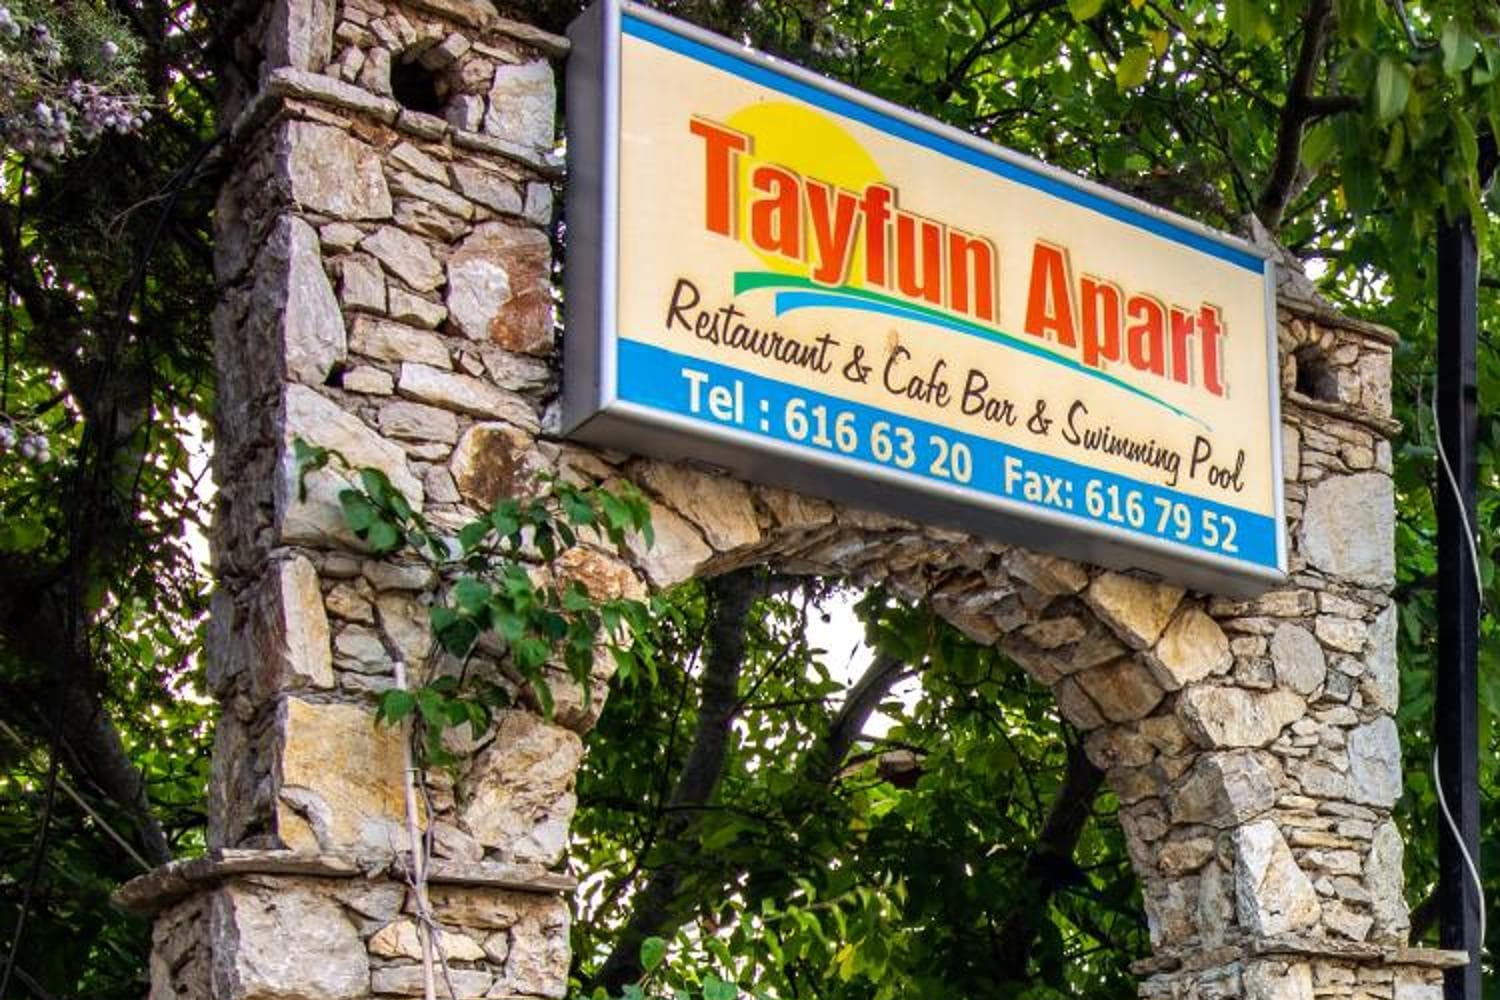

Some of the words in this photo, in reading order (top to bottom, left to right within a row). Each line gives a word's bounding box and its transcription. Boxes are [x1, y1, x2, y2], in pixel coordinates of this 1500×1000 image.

[689, 117, 995, 322] Tayfun
[1023, 242, 1224, 397] Apart
[665, 278, 840, 374] Restaurant
[843, 345, 872, 385] &
[883, 345, 951, 408] Cafe
[961, 368, 1017, 427] Bar
[1027, 399, 1053, 436] &
[1062, 399, 1181, 487] Swimming
[1189, 435, 1245, 493] Pool
[681, 367, 744, 424] Tel
[784, 397, 859, 453] 616
[869, 420, 917, 469] 63
[929, 434, 973, 484] 20
[1004, 455, 1073, 509] Fax:
[1084, 479, 1145, 529] 616
[1154, 496, 1192, 541] 79
[1201, 509, 1239, 554] 52
